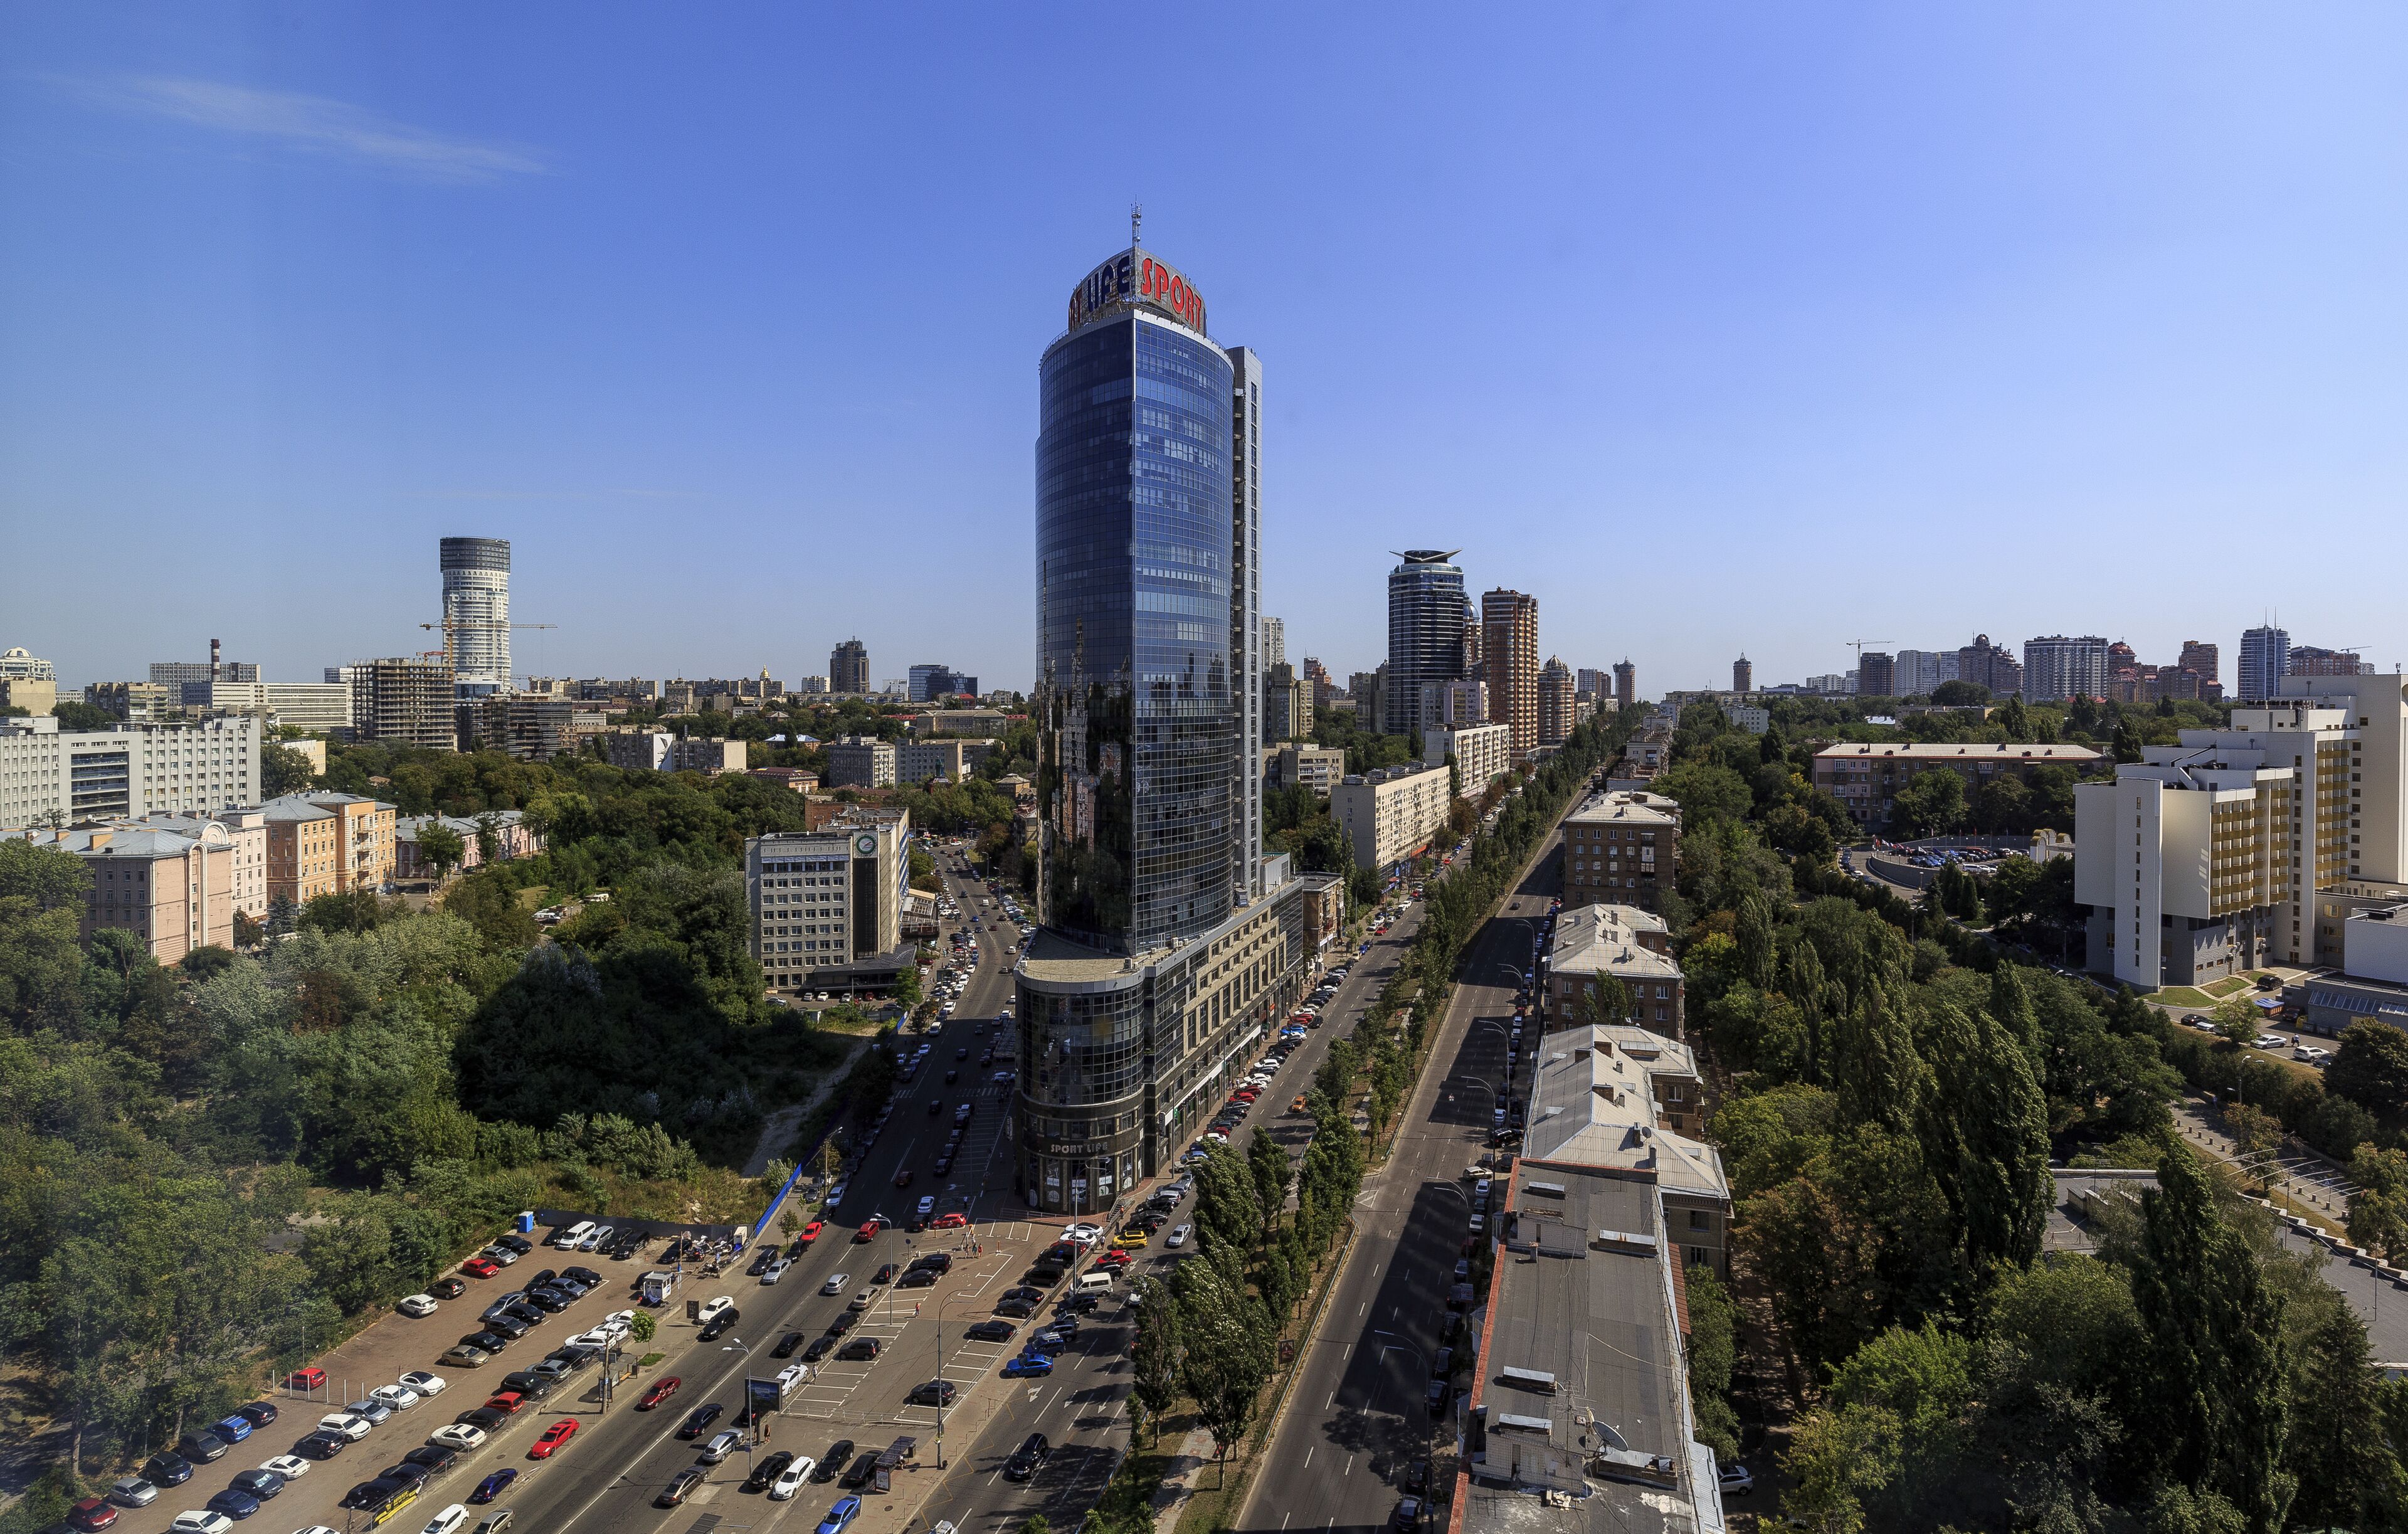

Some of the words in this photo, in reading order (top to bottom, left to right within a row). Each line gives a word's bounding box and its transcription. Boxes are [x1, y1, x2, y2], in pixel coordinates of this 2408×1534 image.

[1087, 254, 1131, 312] LIFE
[1141, 257, 1201, 332] SPORT
[1050, 1144, 1083, 1153] SPORT
[1087, 1142, 1108, 1153] LIFE
